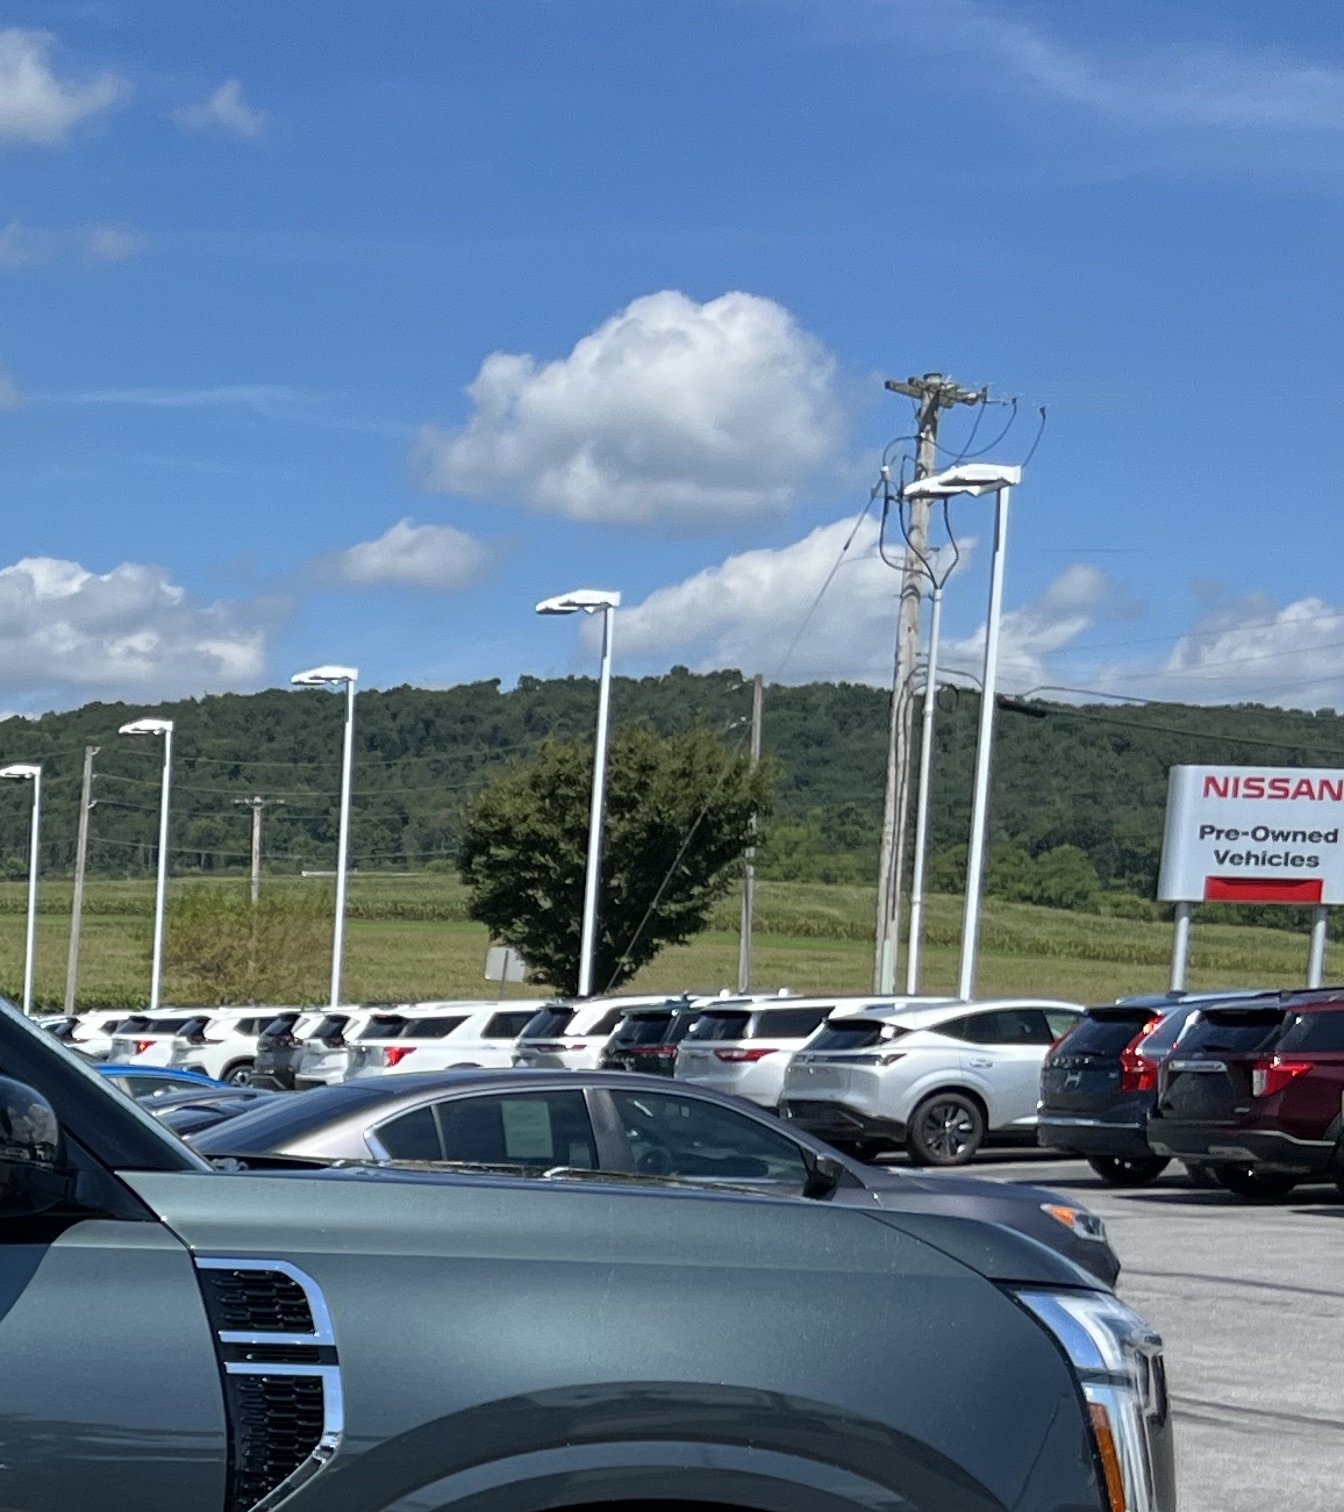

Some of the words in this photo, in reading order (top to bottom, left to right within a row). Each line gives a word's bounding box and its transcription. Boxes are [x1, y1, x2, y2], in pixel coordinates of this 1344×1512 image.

[1202, 775, 1344, 802] NISSAN
[1199, 823, 1339, 844] Pre-Owned
[1213, 849, 1321, 868] Vehicles
